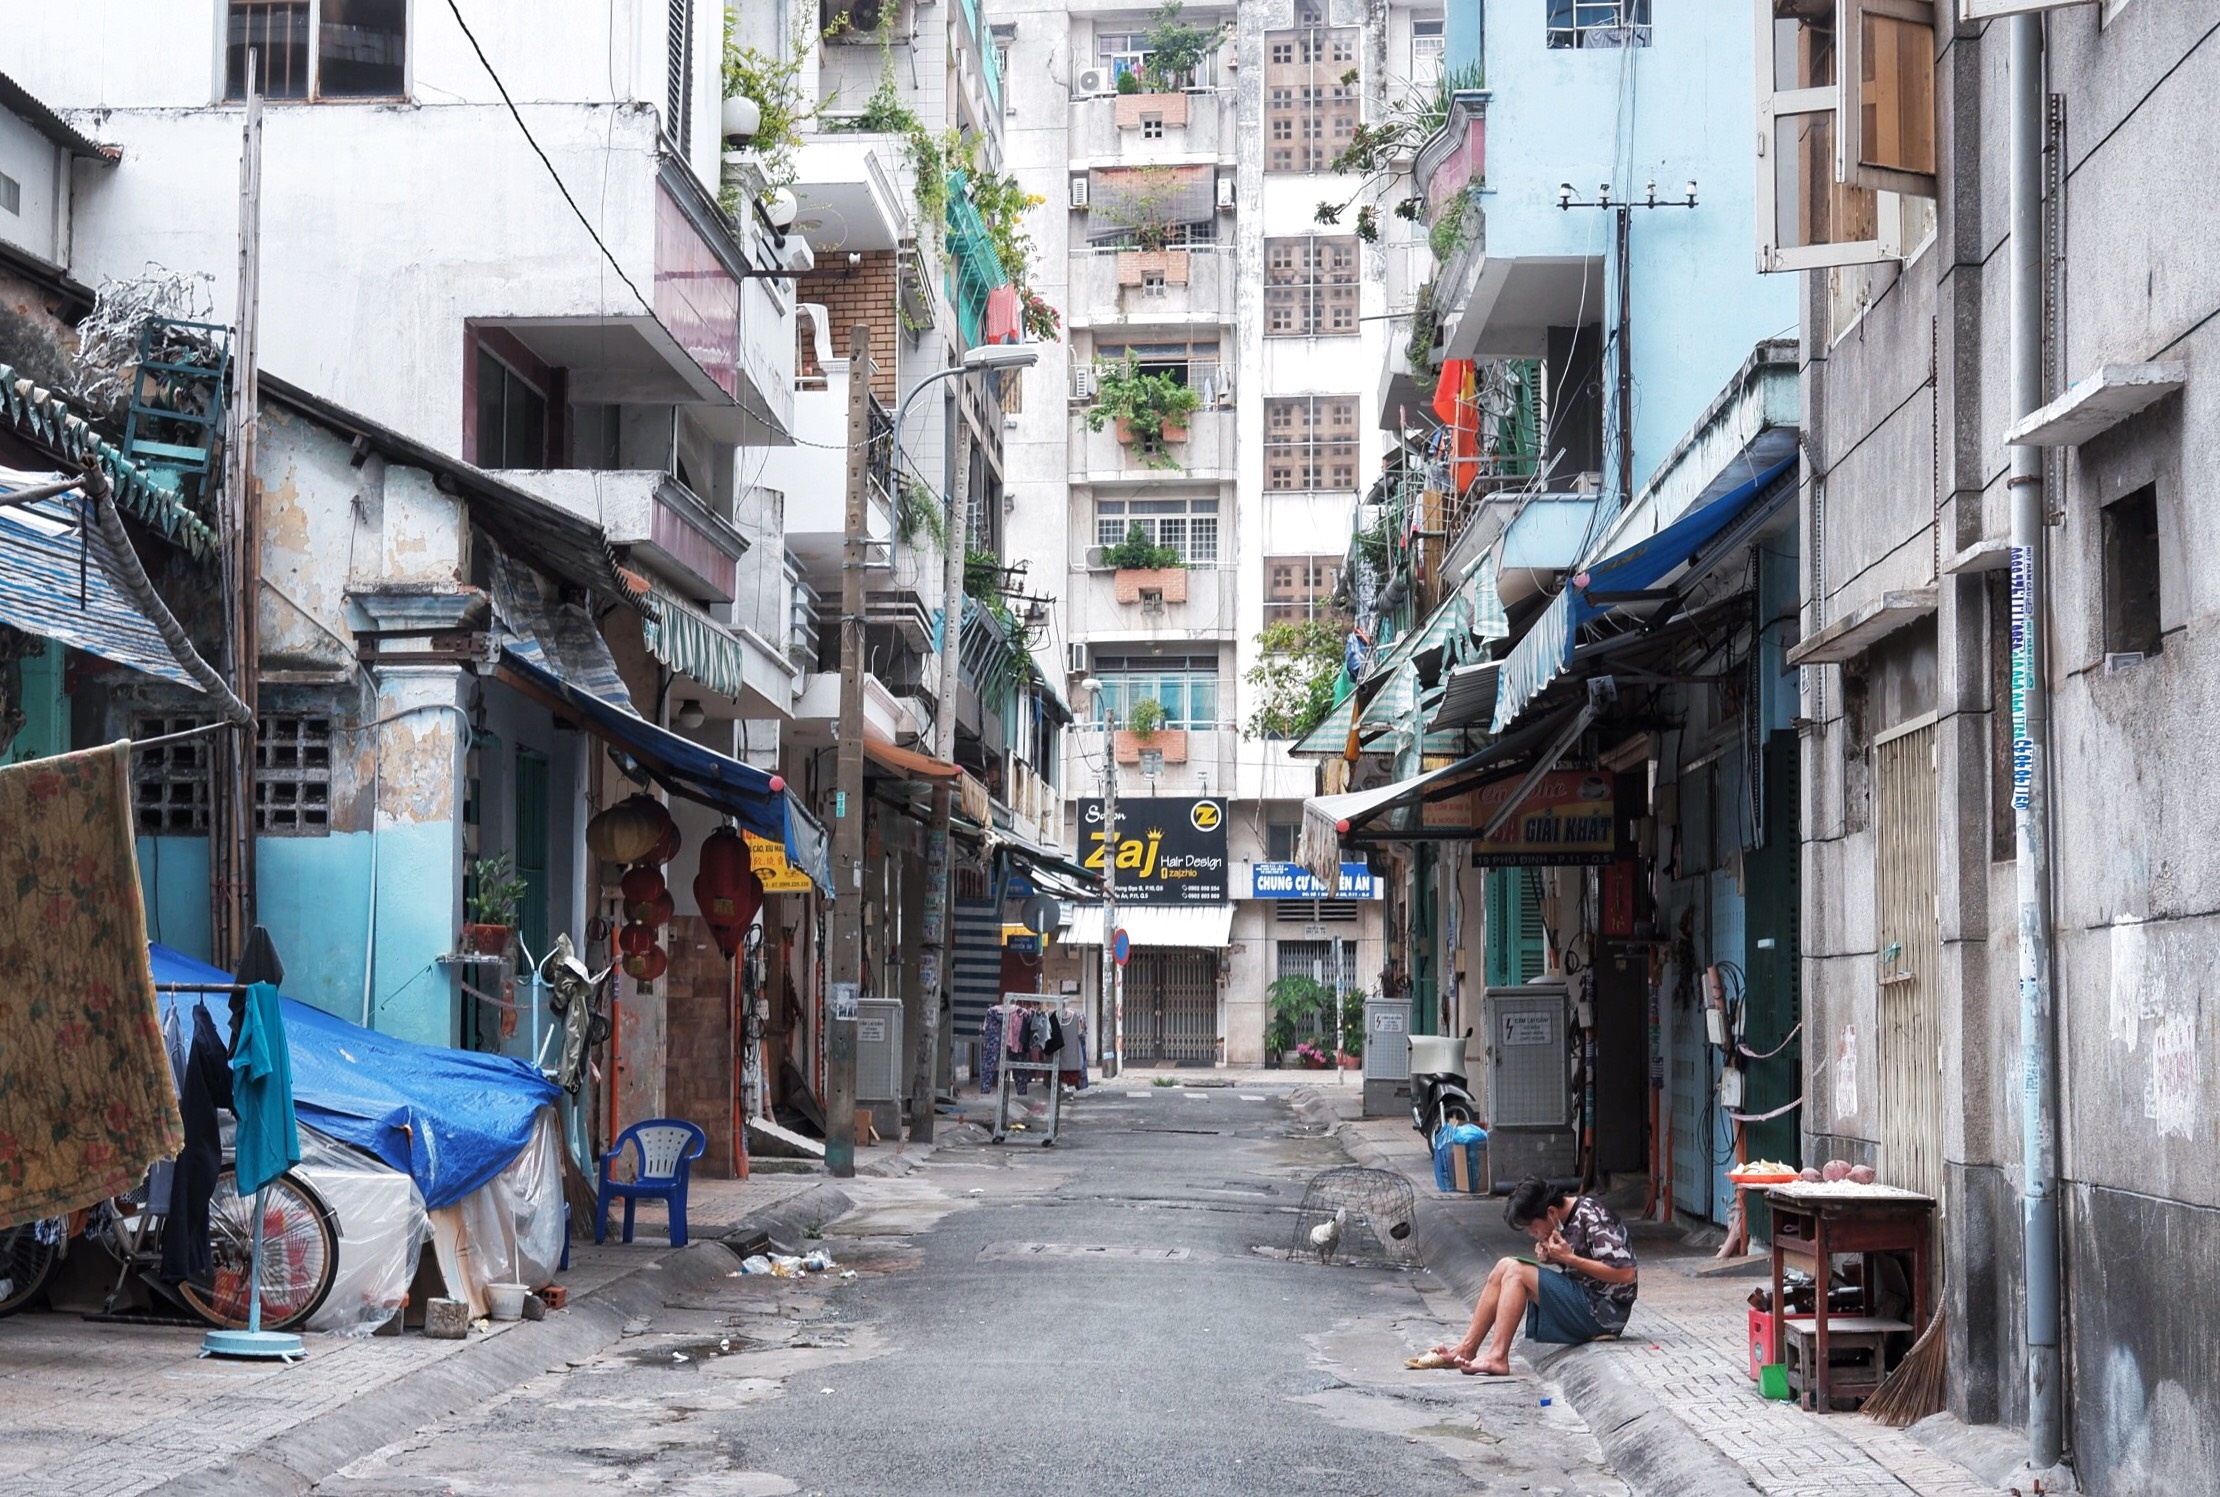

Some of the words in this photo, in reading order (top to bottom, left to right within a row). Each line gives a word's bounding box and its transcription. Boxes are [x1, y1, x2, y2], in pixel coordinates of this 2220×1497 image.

[1084, 832, 1159, 878] Zaj
[1160, 856, 1183, 867] Hair
[1185, 855, 1222, 870] Design
[1257, 876, 1292, 891] CHUNG
[1295, 874, 1310, 891] CƯ
